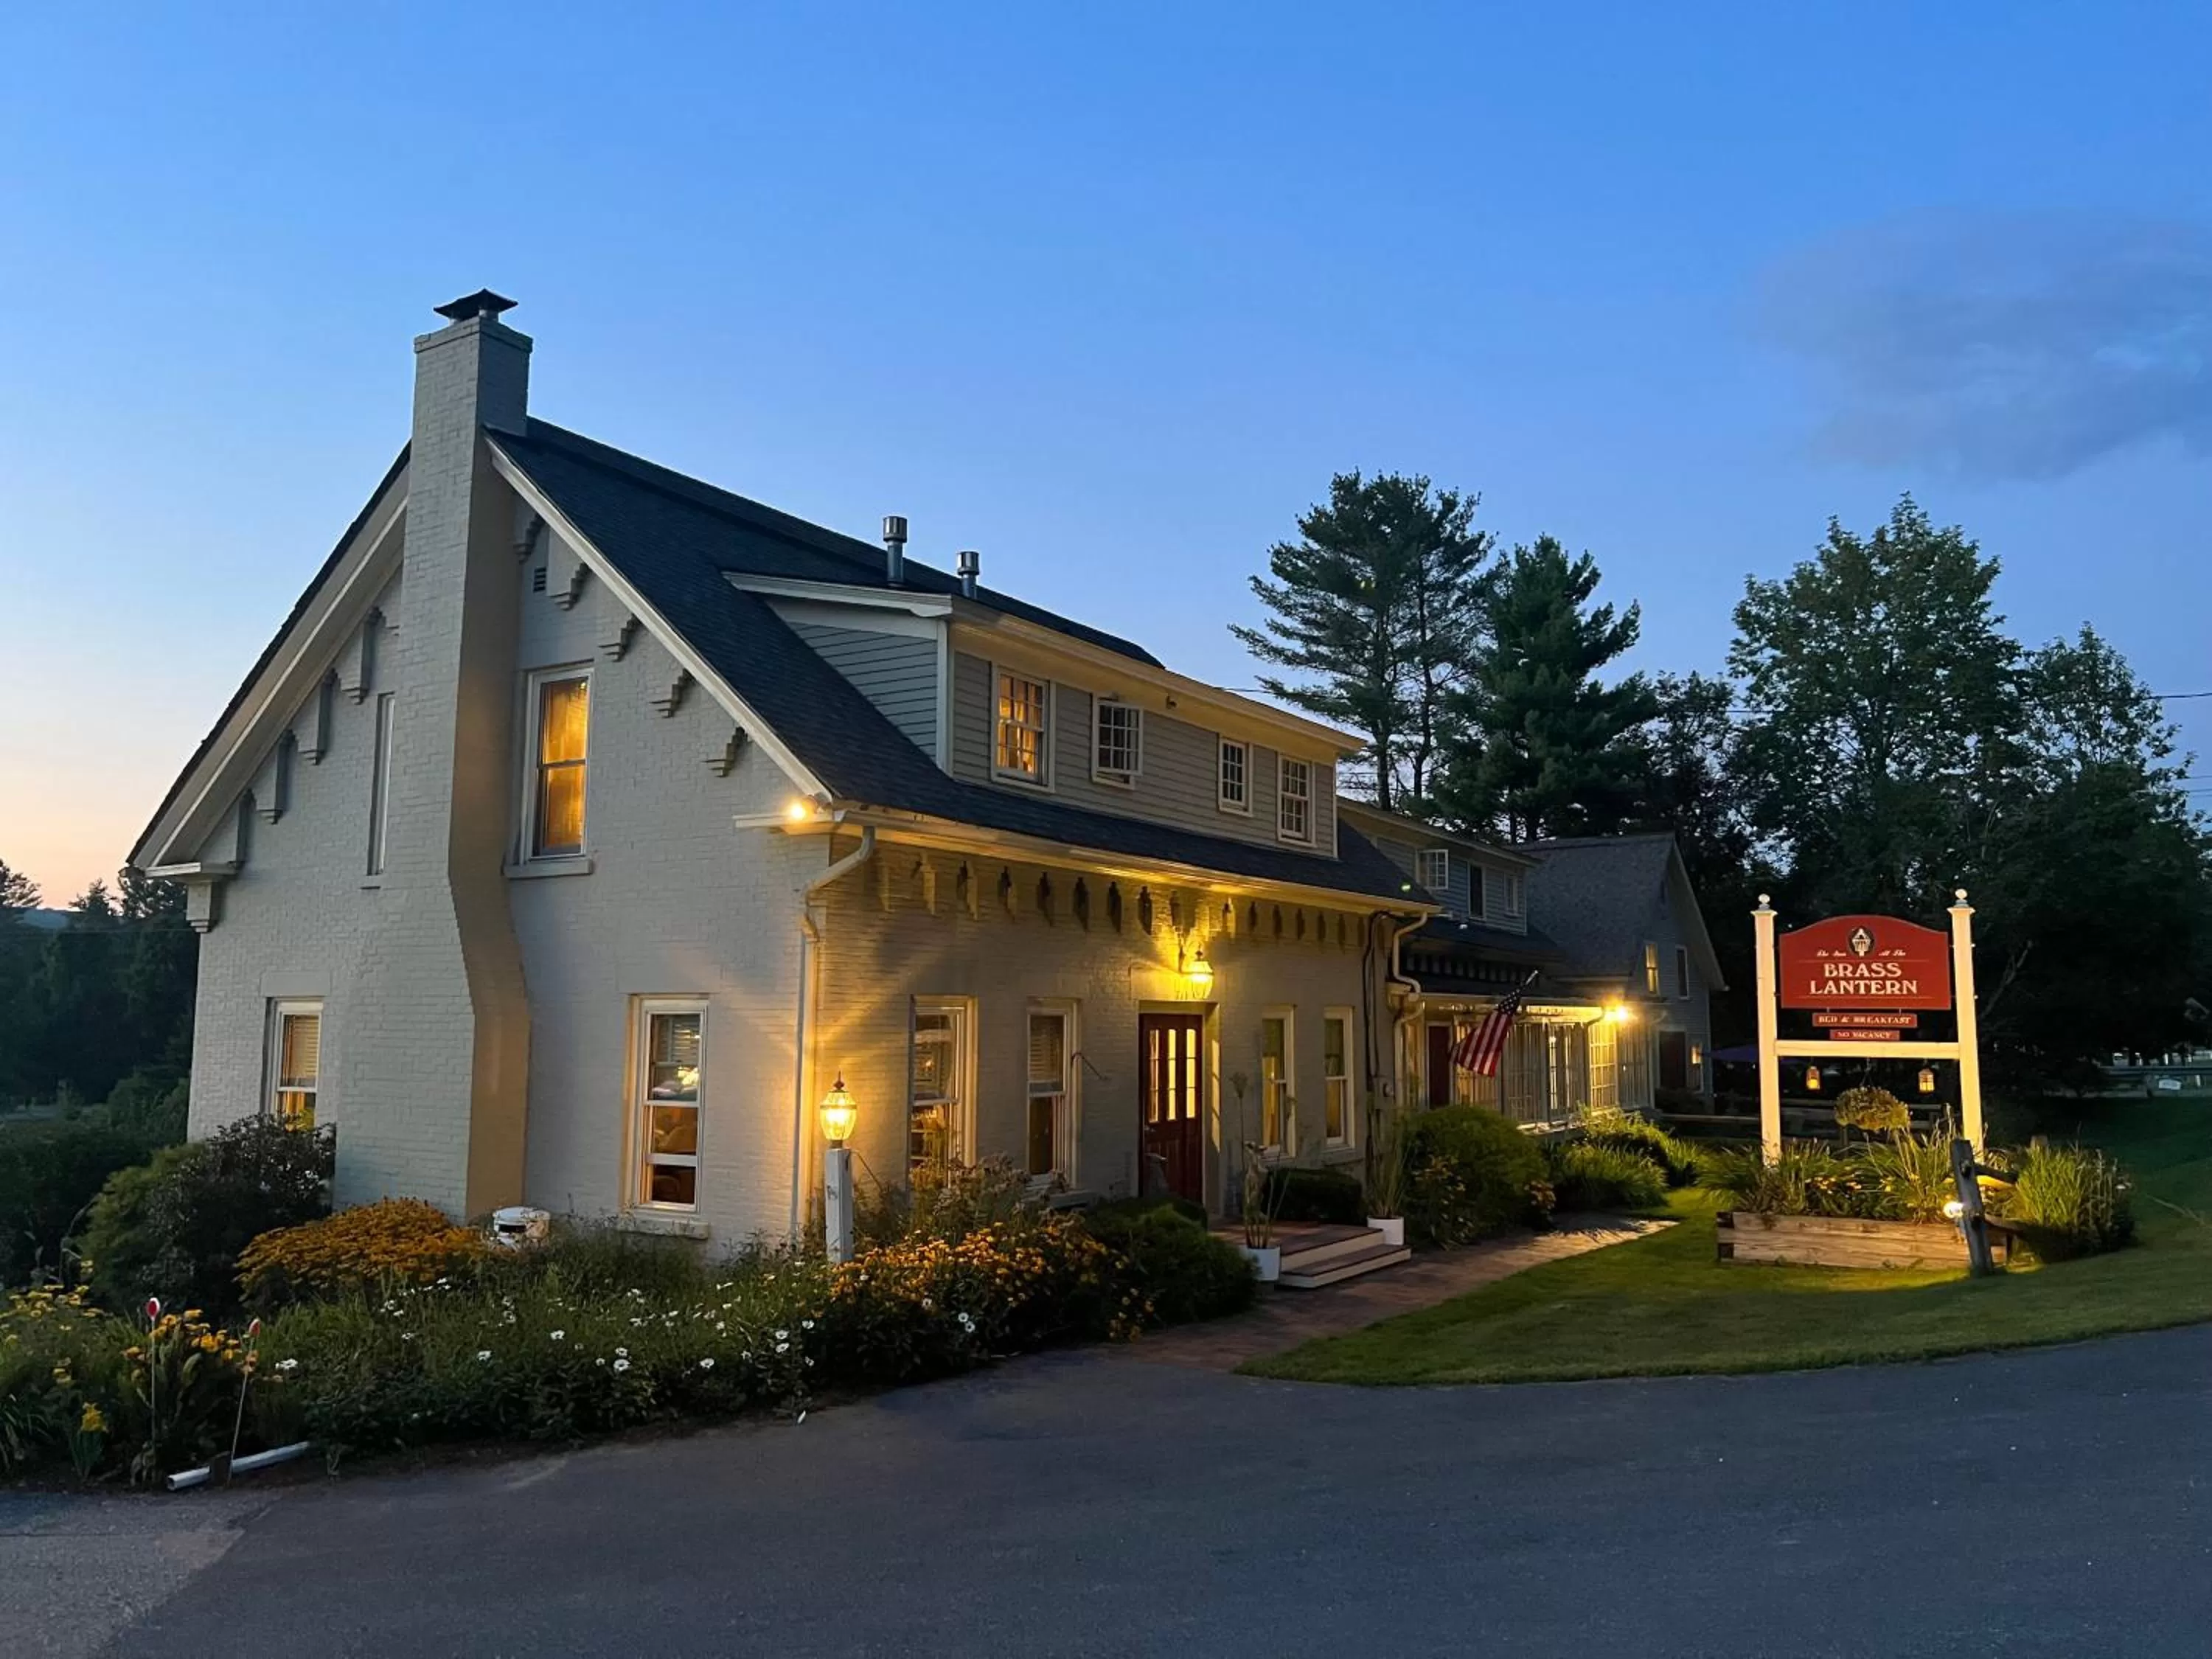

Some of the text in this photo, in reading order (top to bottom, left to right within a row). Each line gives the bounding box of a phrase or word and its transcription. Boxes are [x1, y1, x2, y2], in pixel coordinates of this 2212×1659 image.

[1824, 963, 1901, 977] BRASS
[1810, 980, 1917, 995] LANTERN
[1853, 1016, 1911, 1024] BREAKFAST
